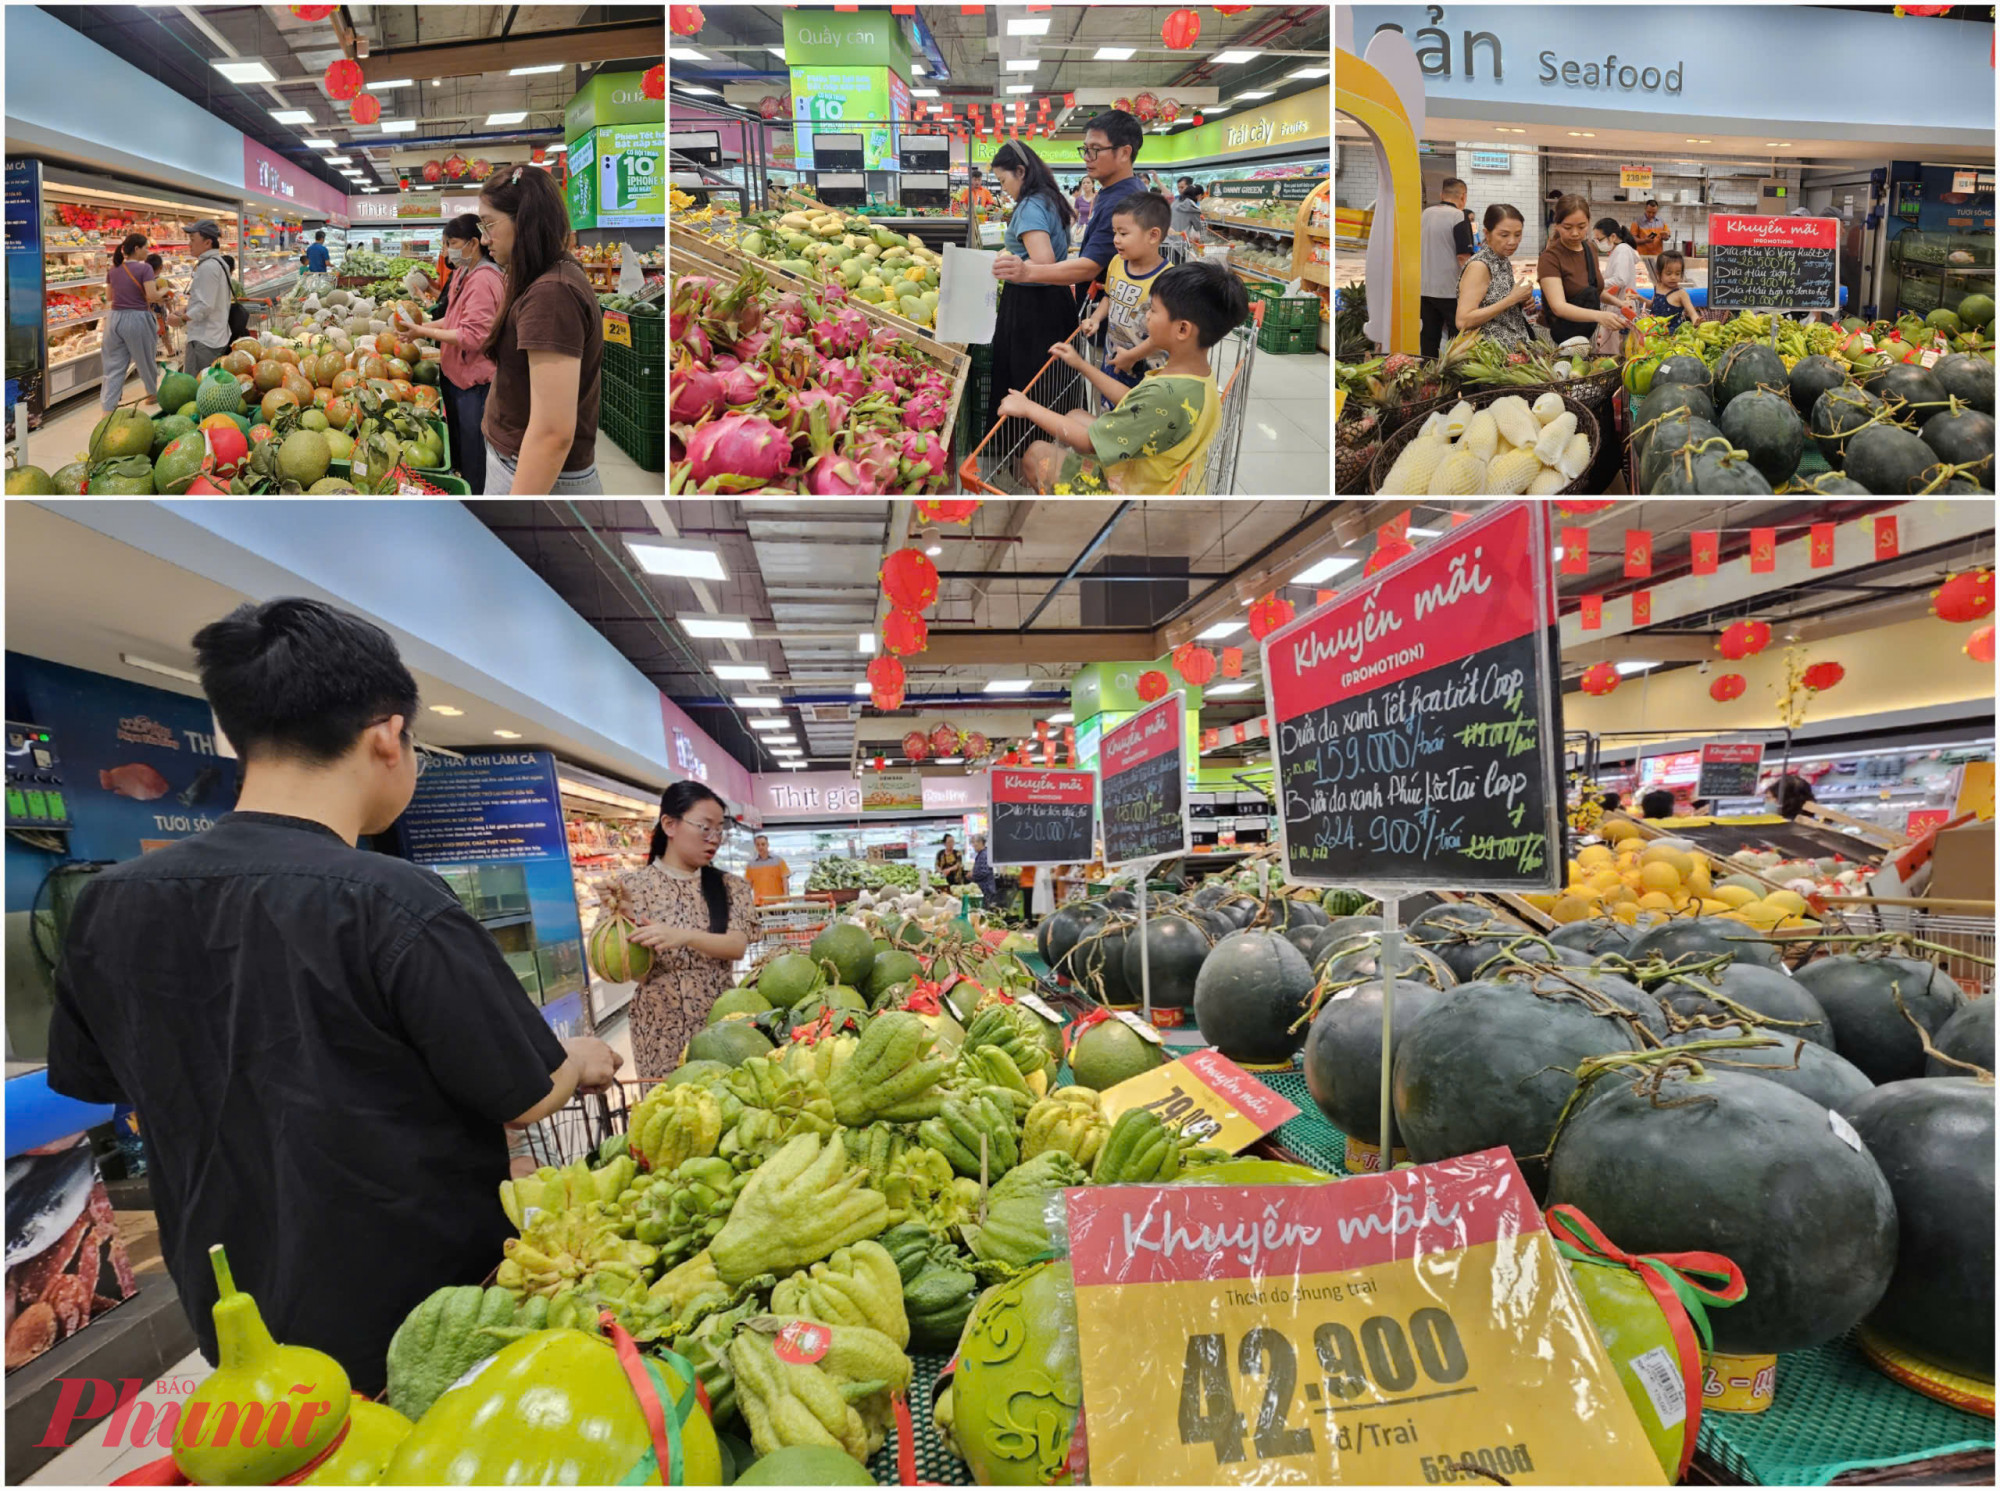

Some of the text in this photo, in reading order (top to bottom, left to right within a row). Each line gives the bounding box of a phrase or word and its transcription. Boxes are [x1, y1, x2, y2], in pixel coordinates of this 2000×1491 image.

[799, 26, 874, 47] Quầy cân
[1375, 4, 1684, 93] ản Seafood
[815, 99, 843, 120] 10
[1227, 117, 1308, 146] Trái cây Fruits
[623, 156, 655, 176] 10
[627, 176, 658, 185] iPHONE
[1241, 186, 1262, 194] GREEN
[357, 202, 387, 219] Thịt
[1727, 218, 1819, 237] Khuyến mãi
[1293, 546, 1492, 676] Khuyến mãi
[1341, 643, 1425, 687] (PROMOTION)
[1342, 698, 1379, 735] xanh
[1105, 720, 1142, 758] Khuyến
[1145, 711, 1168, 736] mãi
[471, 755, 490, 766] KHI
[492, 753, 518, 766] LÀM
[520, 752, 537, 764] CÁ
[1005, 773, 1083, 793] Khuyến mãi
[770, 787, 819, 811] Thịt
[828, 786, 861, 810] gia
[1349, 783, 1383, 811] xanh
[153, 814, 191, 831] TƯƠI
[1195, 1056, 1273, 1115] Khuyến mãi
[1122, 1187, 1461, 1266] Khuyến mãi
[1271, 1286, 1290, 1304] do
[1347, 1277, 1378, 1297] trai
[1178, 1306, 1469, 1465] 42.900
[1336, 1418, 1419, 1454] đ/Trai
